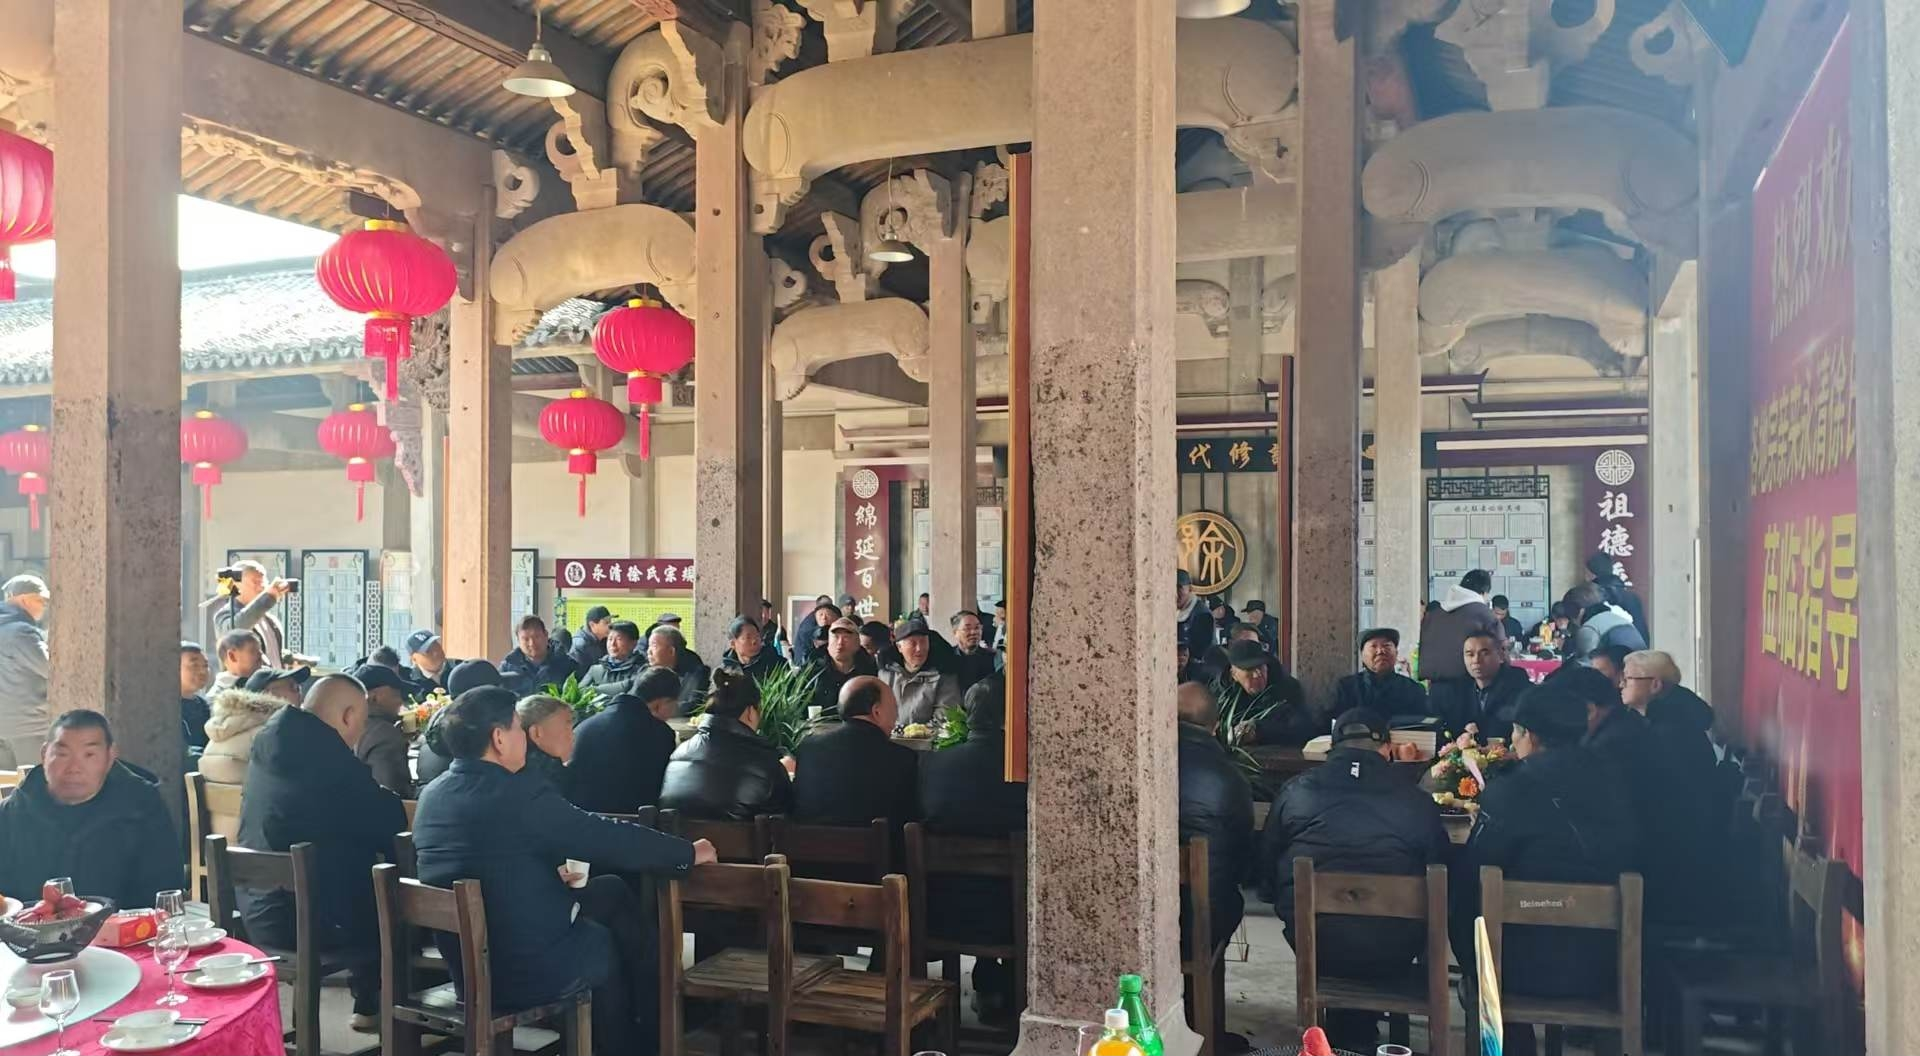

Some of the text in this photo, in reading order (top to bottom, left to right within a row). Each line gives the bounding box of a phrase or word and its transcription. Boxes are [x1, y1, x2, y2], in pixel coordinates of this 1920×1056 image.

[1770, 120, 1853, 344] 热烈欢
[854, 502, 880, 618] 綿延百世
[1762, 513, 1858, 691] 莅临指导
